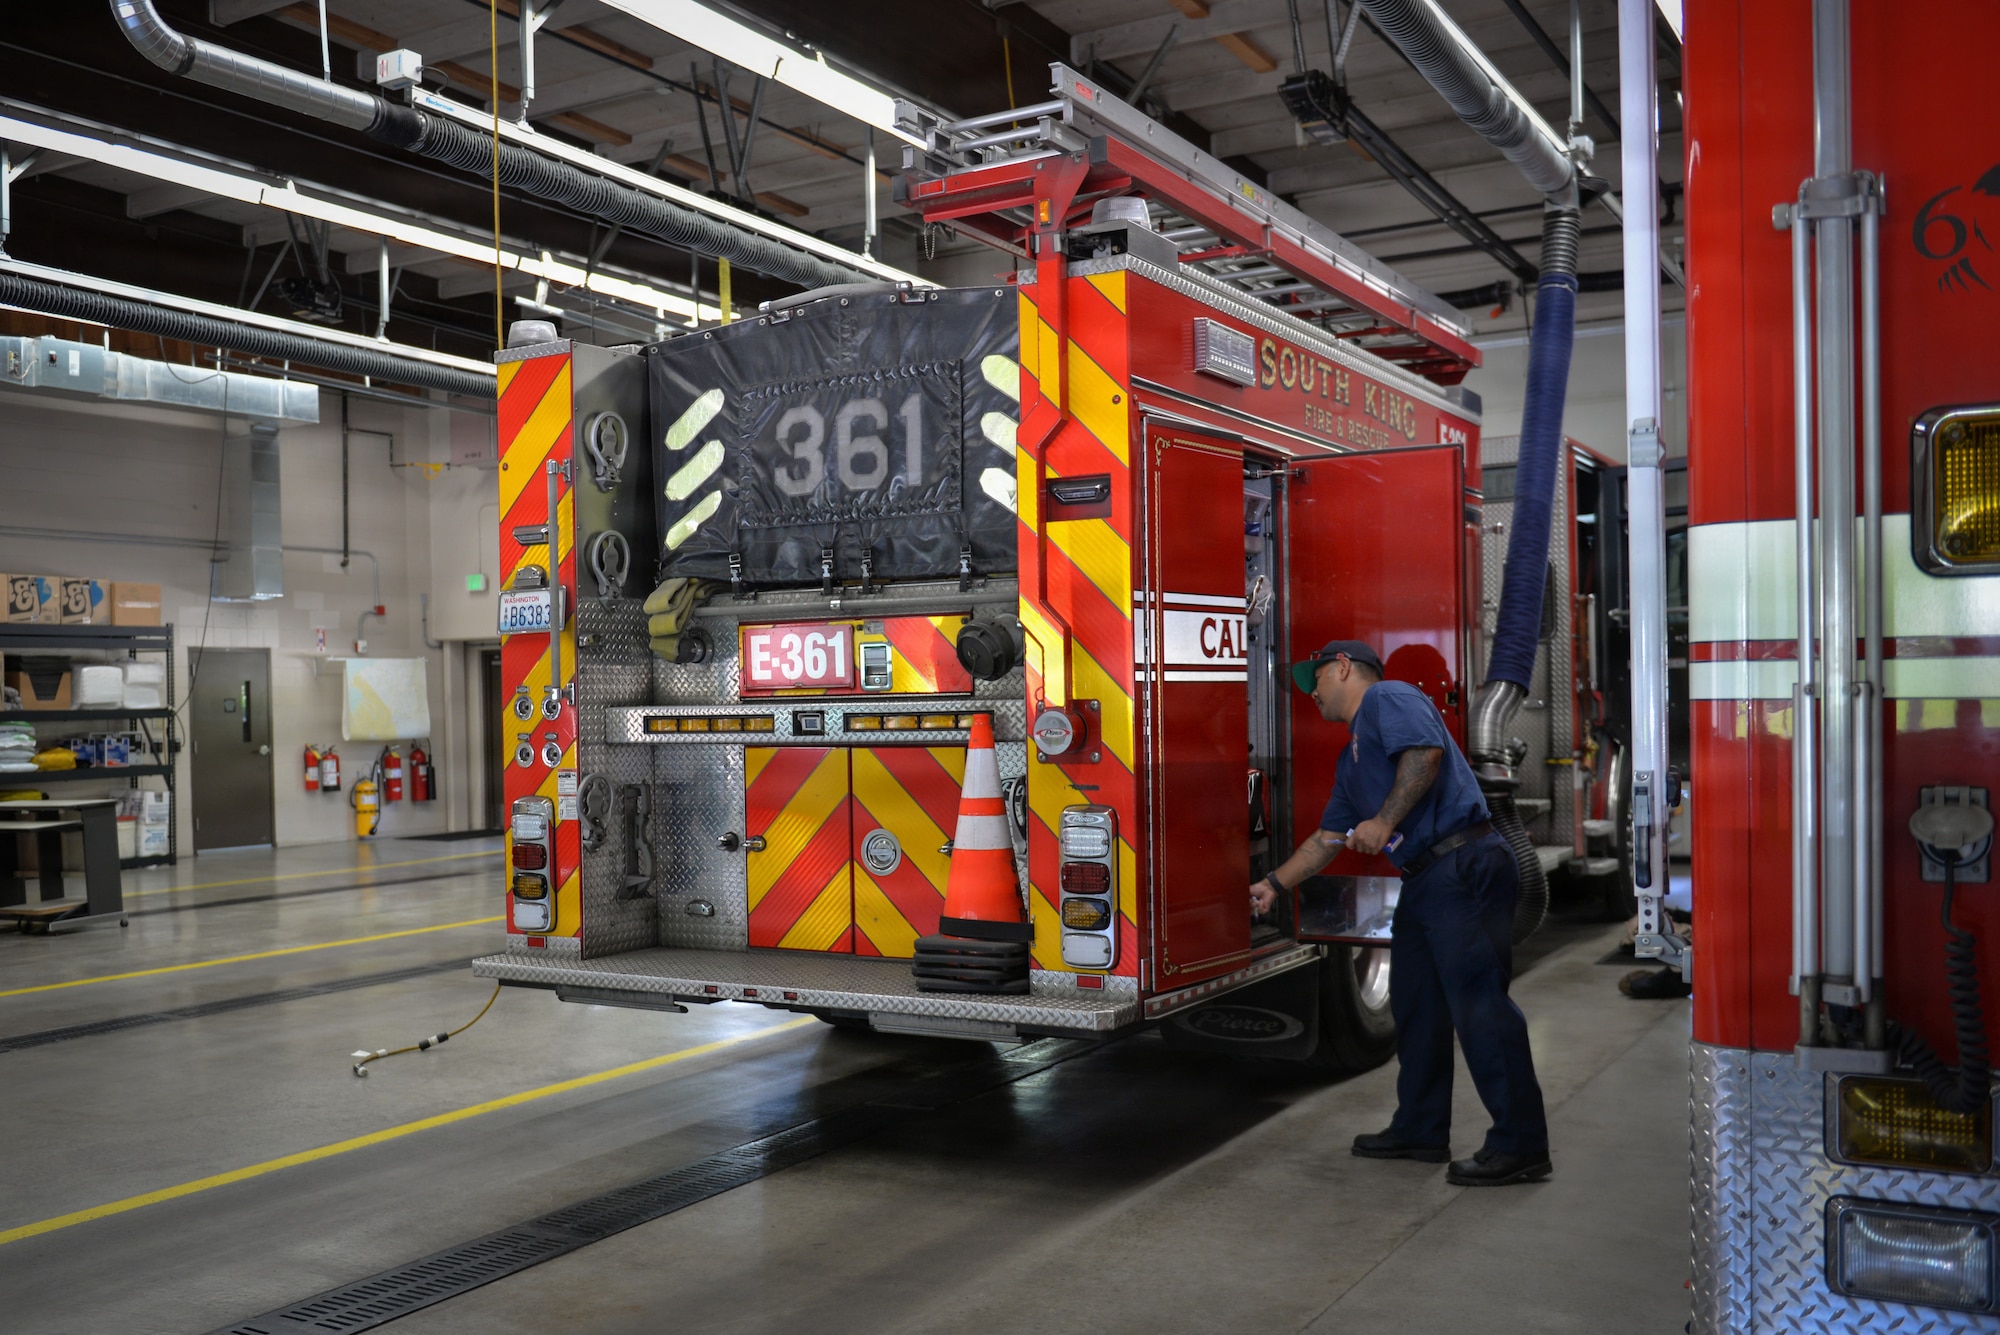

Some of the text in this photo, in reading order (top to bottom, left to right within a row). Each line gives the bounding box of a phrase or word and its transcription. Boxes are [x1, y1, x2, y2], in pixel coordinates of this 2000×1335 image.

[1261, 338, 1415, 441] SOUTH KING
[774, 393, 922, 497] 361
[1304, 404, 1389, 449] FIRE & RESCUE
[750, 631, 845, 680] E-361
[1200, 617, 1247, 658] CAL
[1196, 1010, 1279, 1032] Pierce
